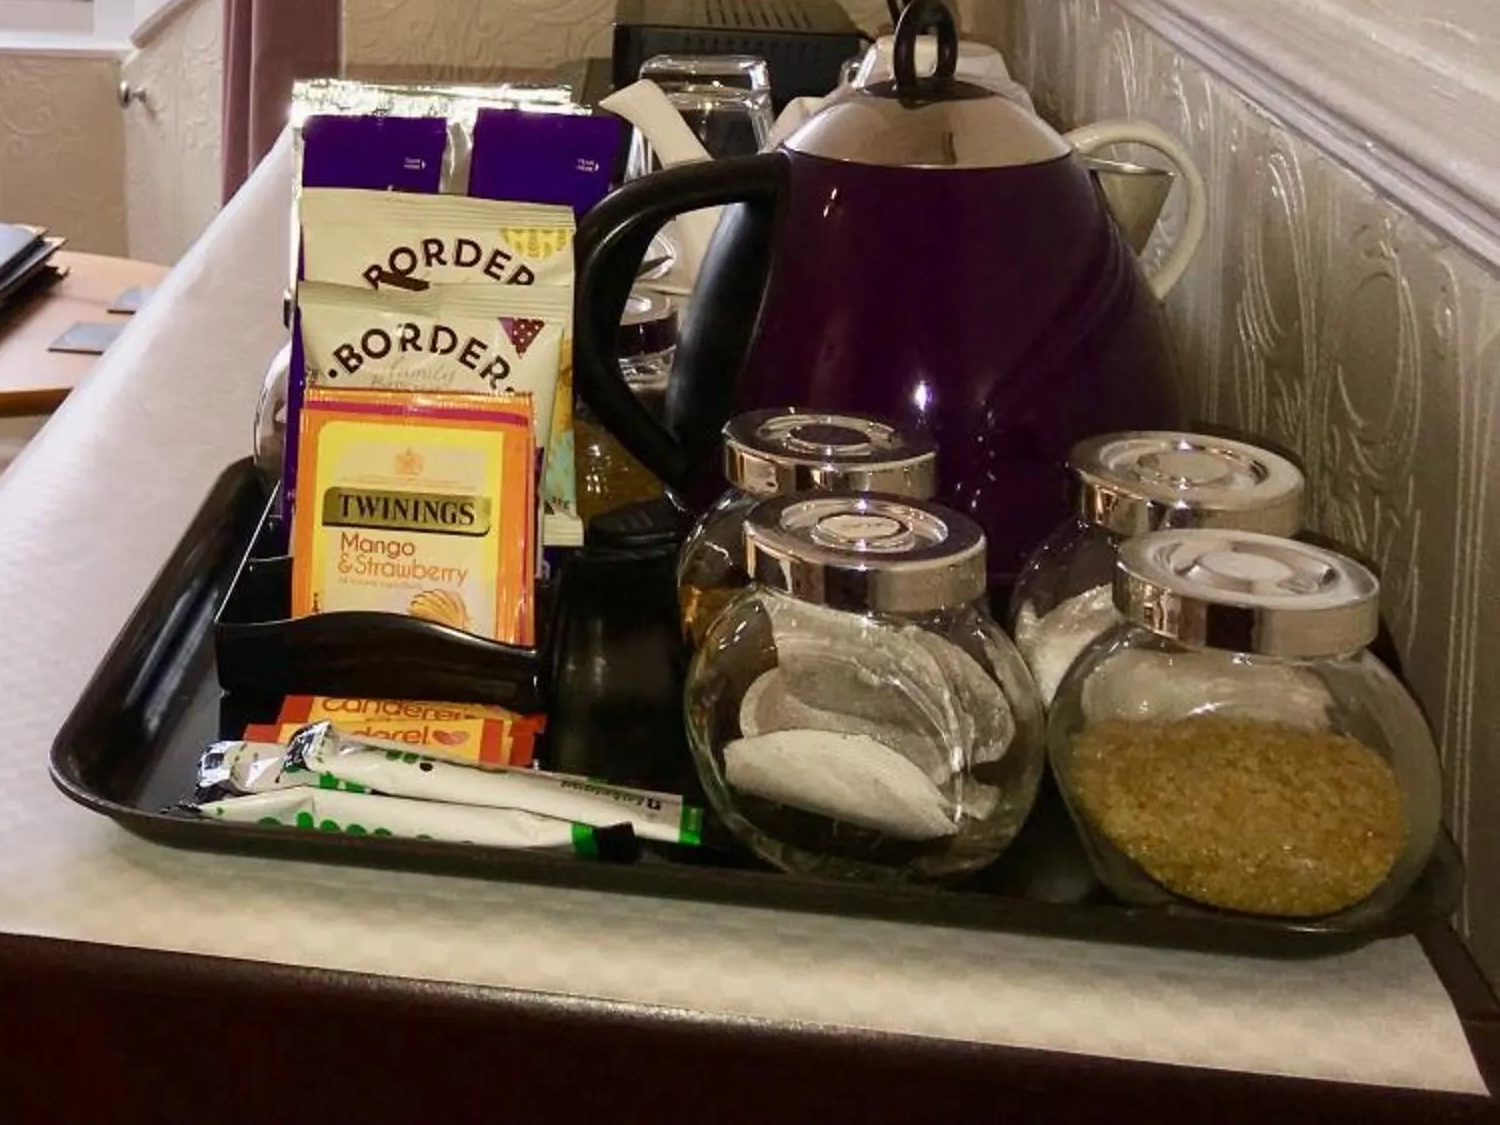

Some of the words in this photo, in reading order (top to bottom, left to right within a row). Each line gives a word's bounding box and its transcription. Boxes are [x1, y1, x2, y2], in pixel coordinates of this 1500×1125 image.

[332, 322, 512, 390] BORDER
[338, 493, 476, 526] TWININGS
[340, 531, 416, 559] Mango
